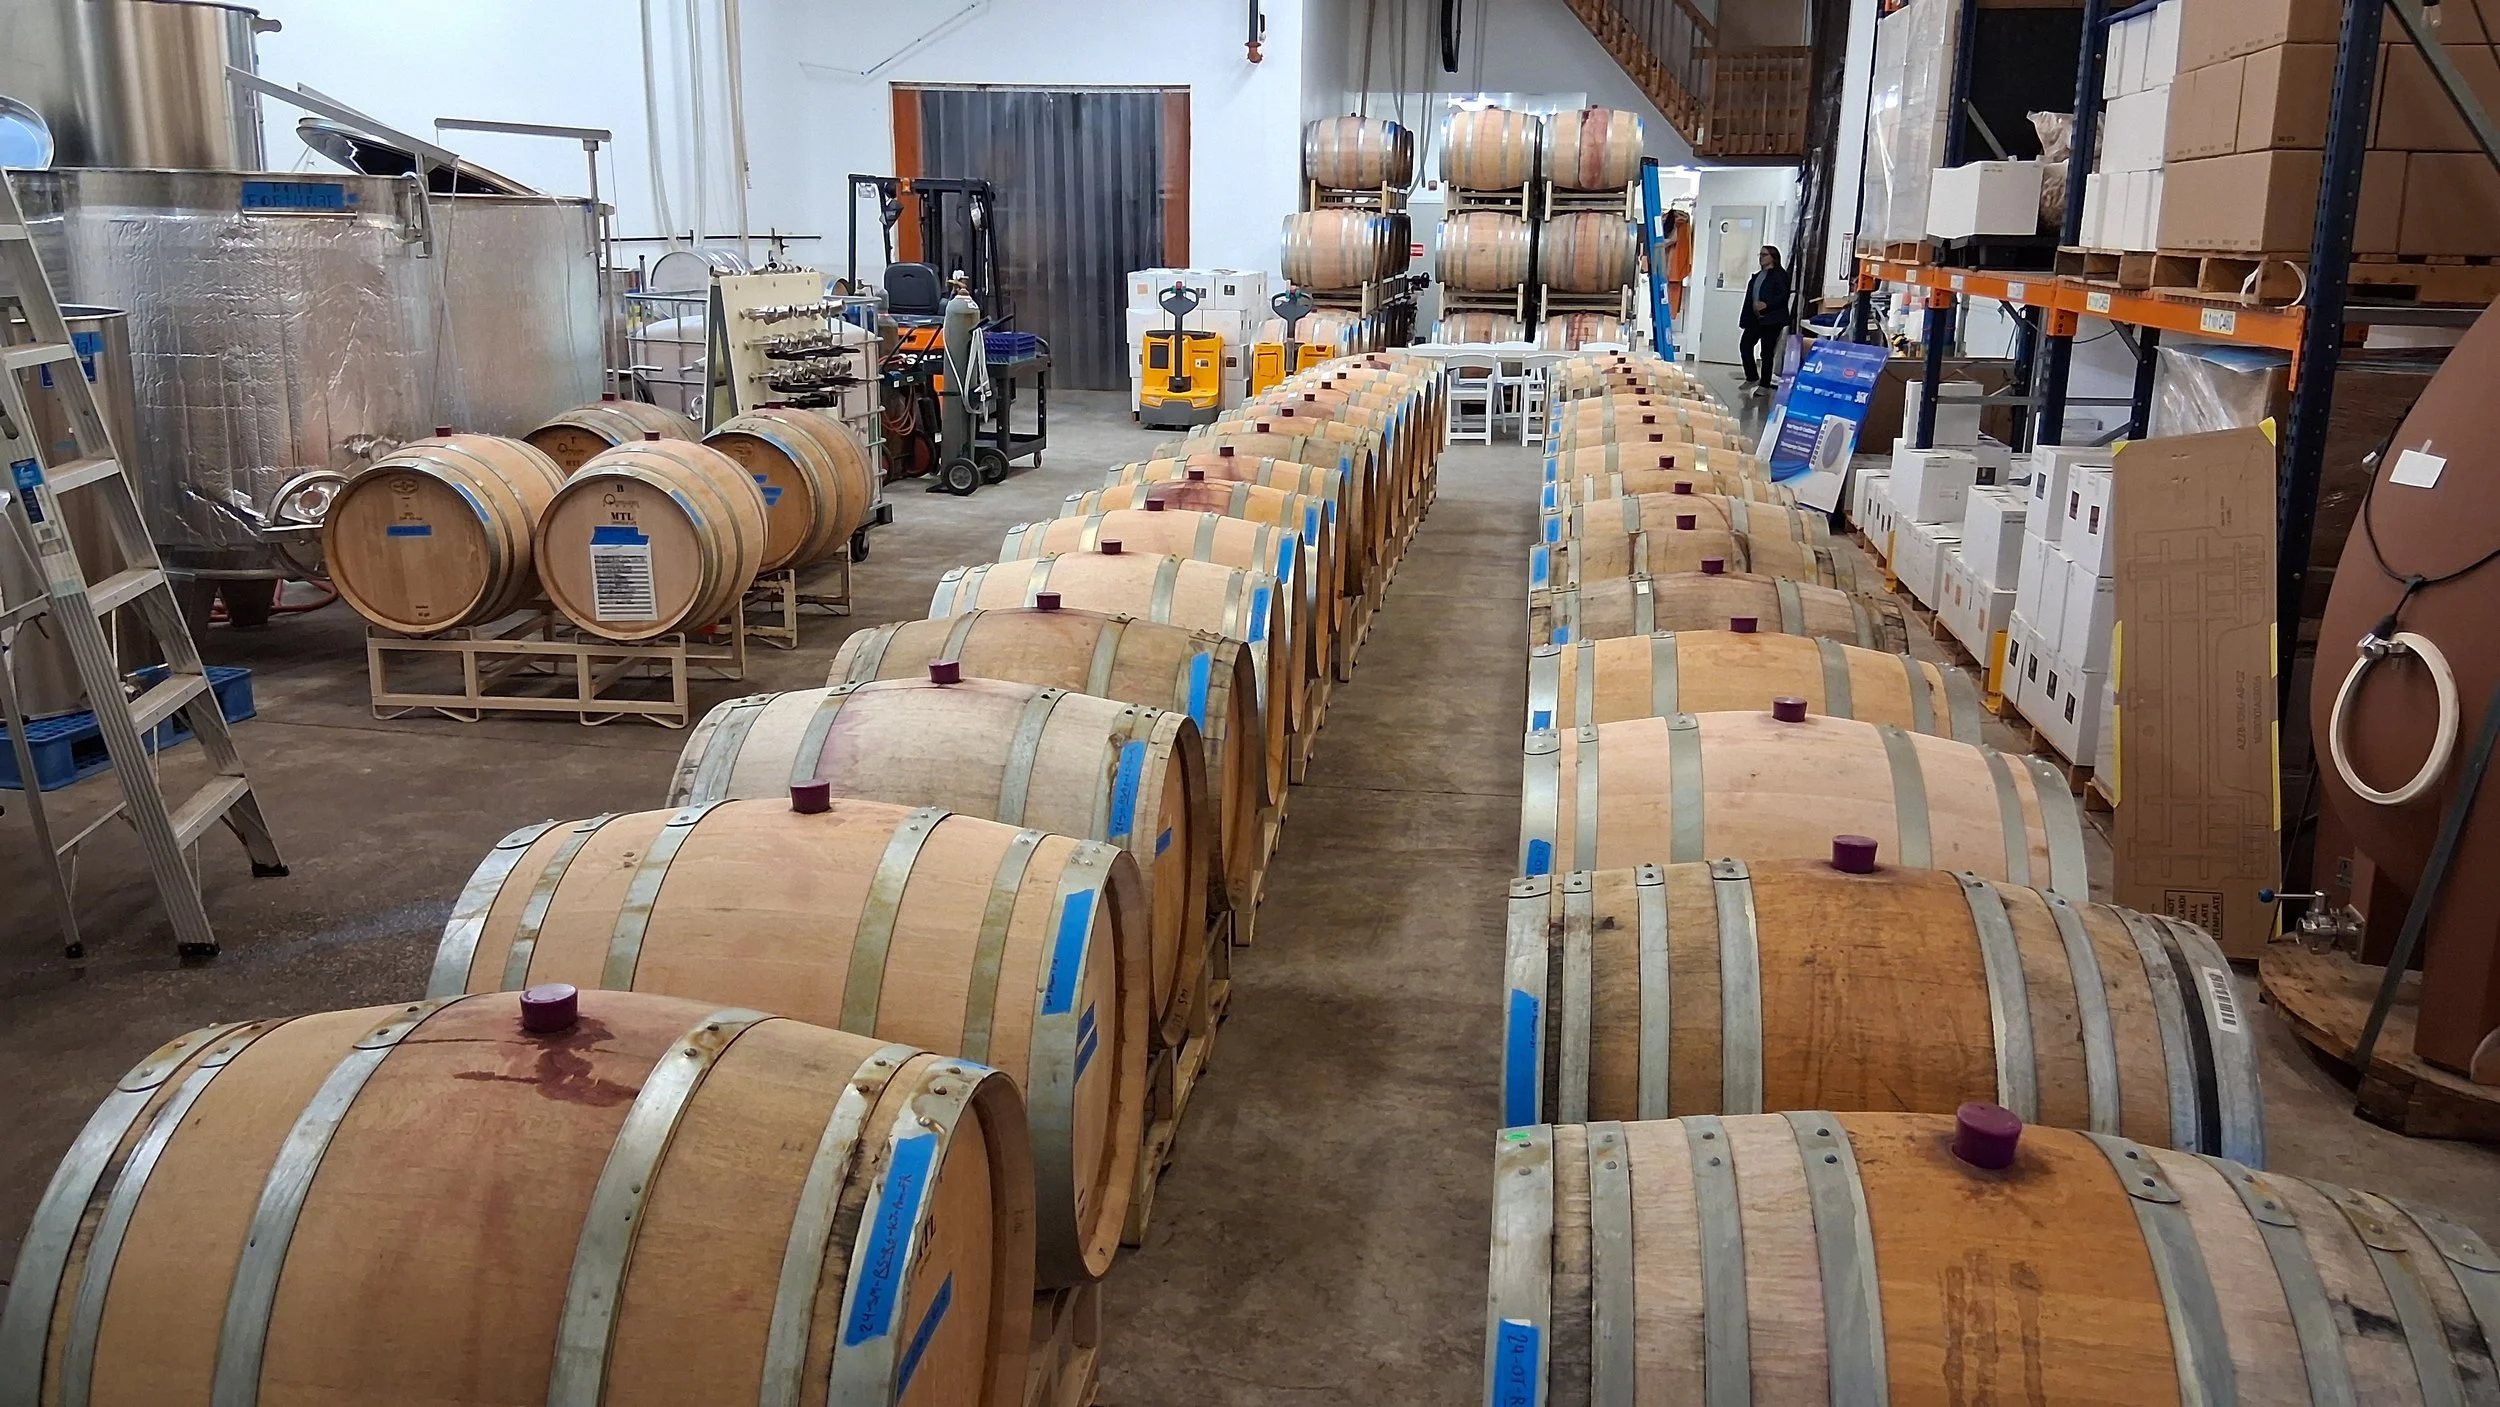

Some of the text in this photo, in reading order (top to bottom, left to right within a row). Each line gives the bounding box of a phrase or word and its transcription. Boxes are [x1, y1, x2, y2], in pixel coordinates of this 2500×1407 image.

[616, 484, 625, 493] B
[611, 512, 634, 521] MTL
[2201, 904, 2209, 928] PLATE
[2212, 896, 2220, 936] TEMPLATE
